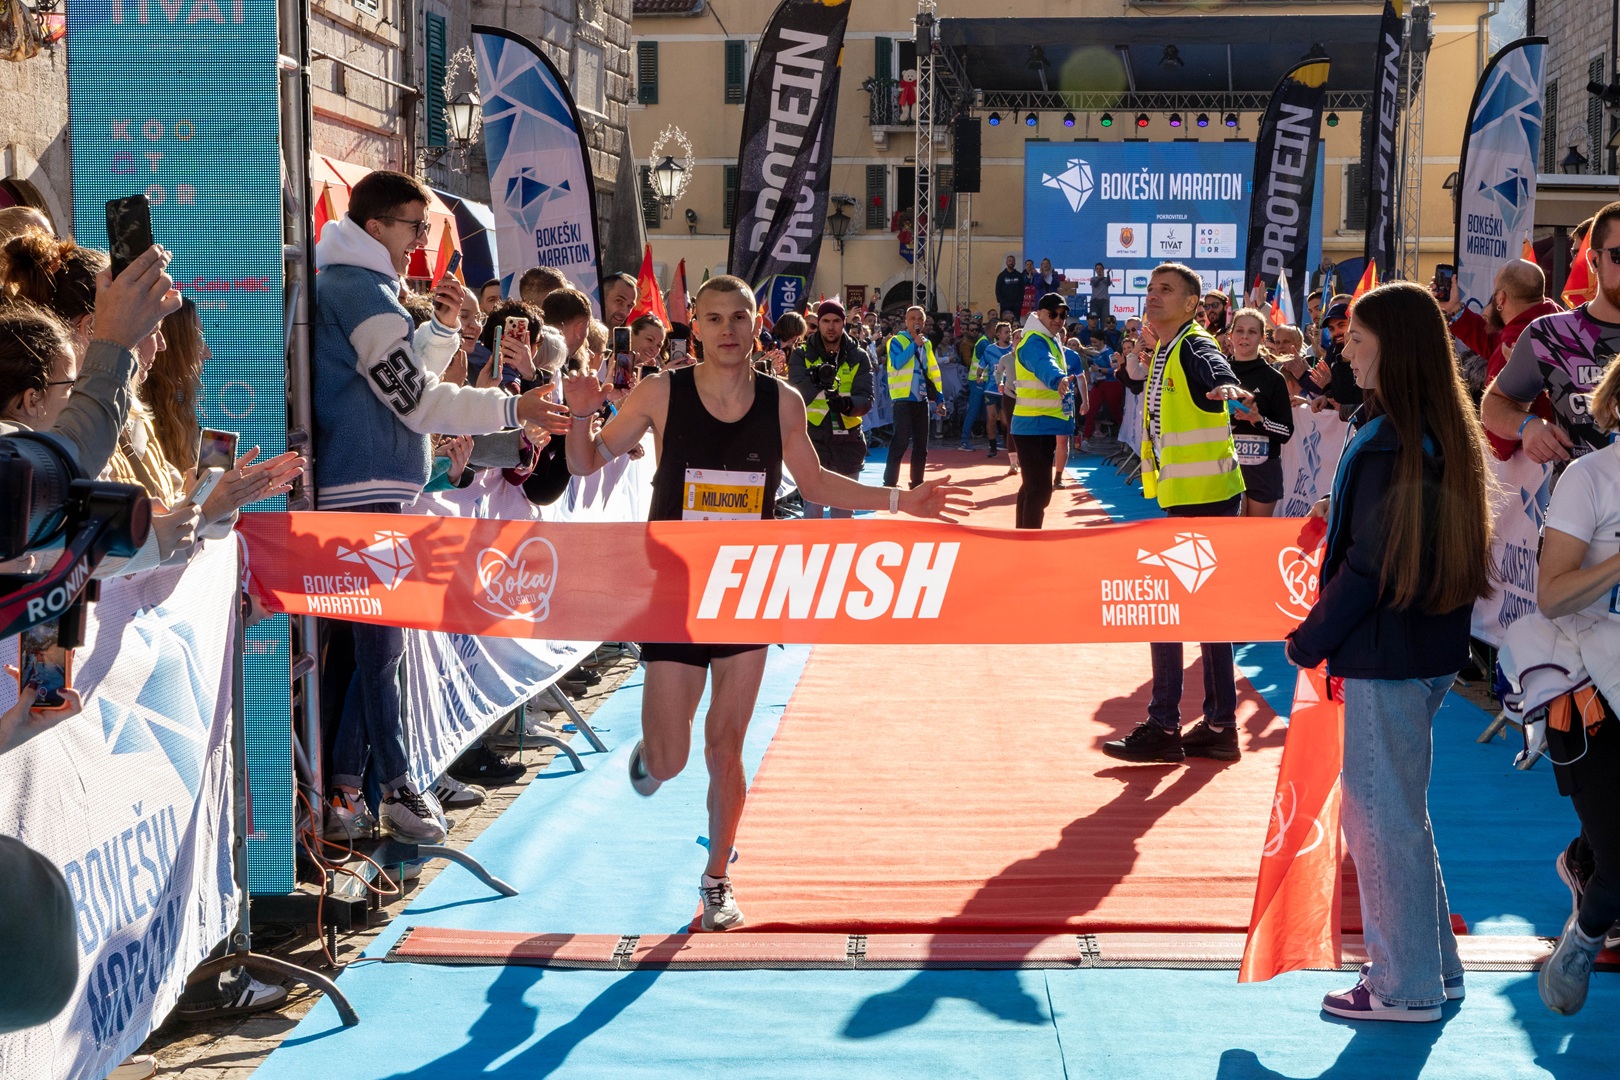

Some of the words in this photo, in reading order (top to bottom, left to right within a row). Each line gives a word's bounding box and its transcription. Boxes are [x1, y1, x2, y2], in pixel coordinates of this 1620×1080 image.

[1101, 167, 1164, 200] BOKEŠKI
[1169, 173, 1242, 200] MARATON
[1262, 103, 1313, 277] PROTEIN
[536, 221, 581, 248] BOKEŠKI
[1467, 213, 1503, 237] BOKEŠKI
[538, 243, 591, 267] MARATON
[1160, 241, 1183, 250] TIVAT
[1466, 234, 1508, 259] MARATON
[779, 279, 798, 315] lek
[1113, 304, 1135, 313] hama
[369, 347, 426, 416] 92
[1235, 442, 1261, 455] 2812
[702, 489, 749, 508] MILJKOVIĆ
[26, 554, 89, 623] RONIN
[303, 571, 370, 596] BOKEŠKI
[483, 560, 551, 604] Boka
[696, 541, 961, 621] FINISH
[1101, 574, 1170, 602] BOKEŠKI
[306, 595, 383, 616] MARATON
[1102, 603, 1181, 627] MARATON
[64, 800, 181, 957] BOKEŠKI
